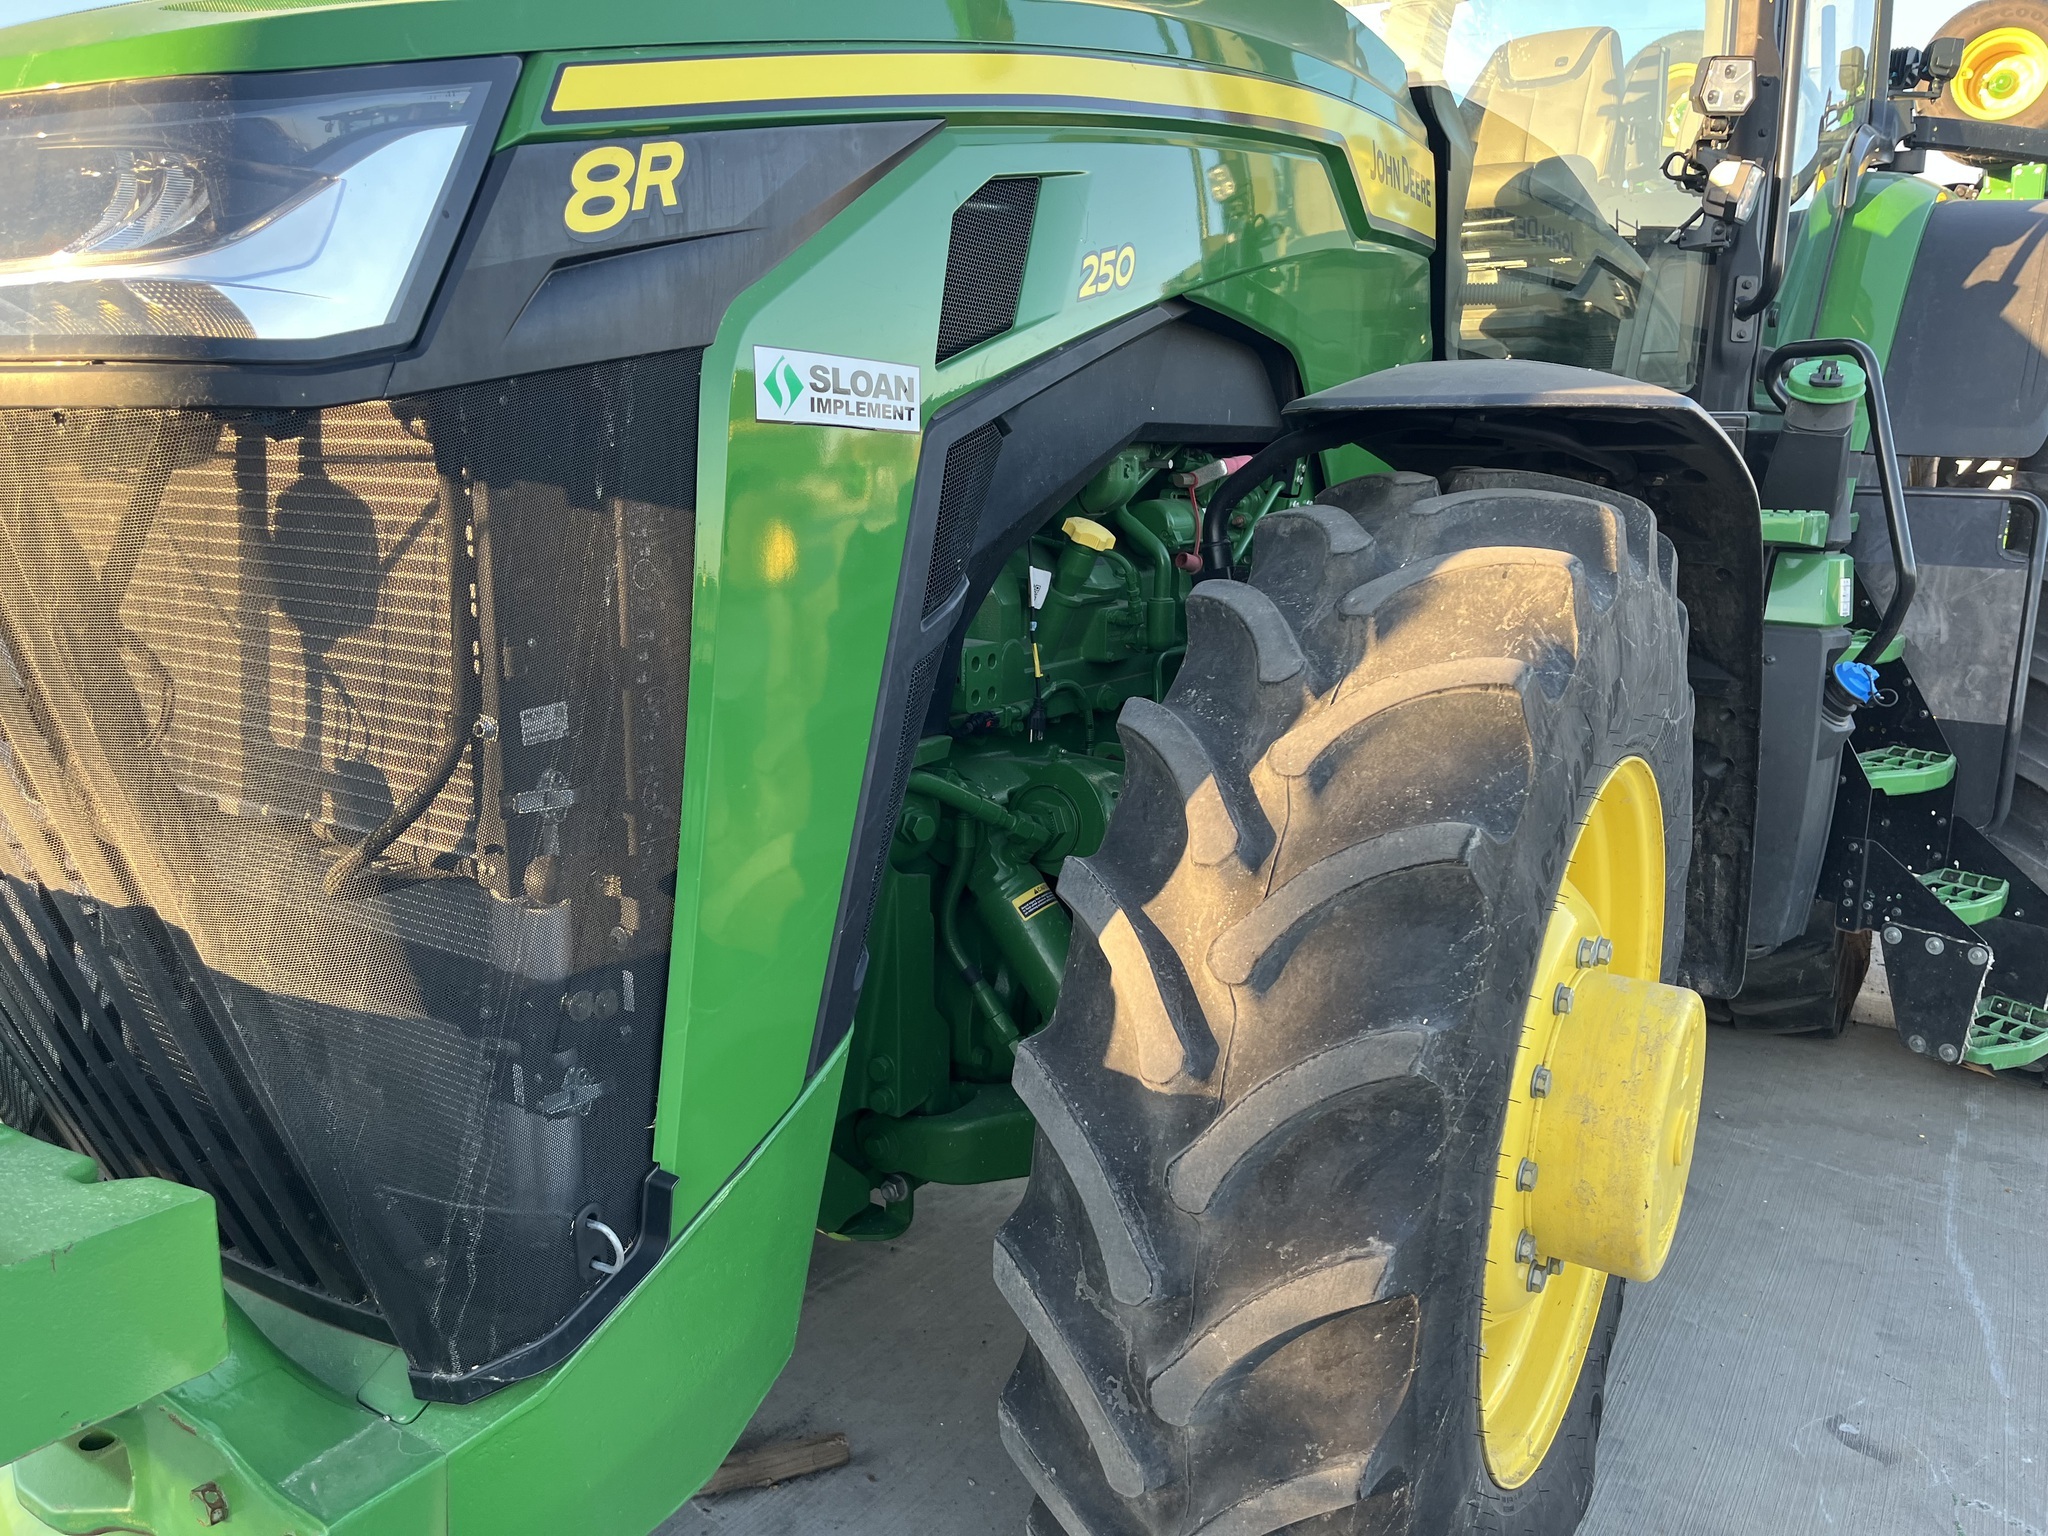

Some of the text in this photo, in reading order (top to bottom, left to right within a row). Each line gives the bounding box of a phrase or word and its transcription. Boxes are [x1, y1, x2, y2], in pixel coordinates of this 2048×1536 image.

[565, 141, 685, 233] 8R
[1370, 139, 1432, 208] JOHN DEERE
[1078, 245, 1136, 300] 250
[809, 364, 915, 403] SLOAN
[810, 396, 915, 421] IMPLEMENT
